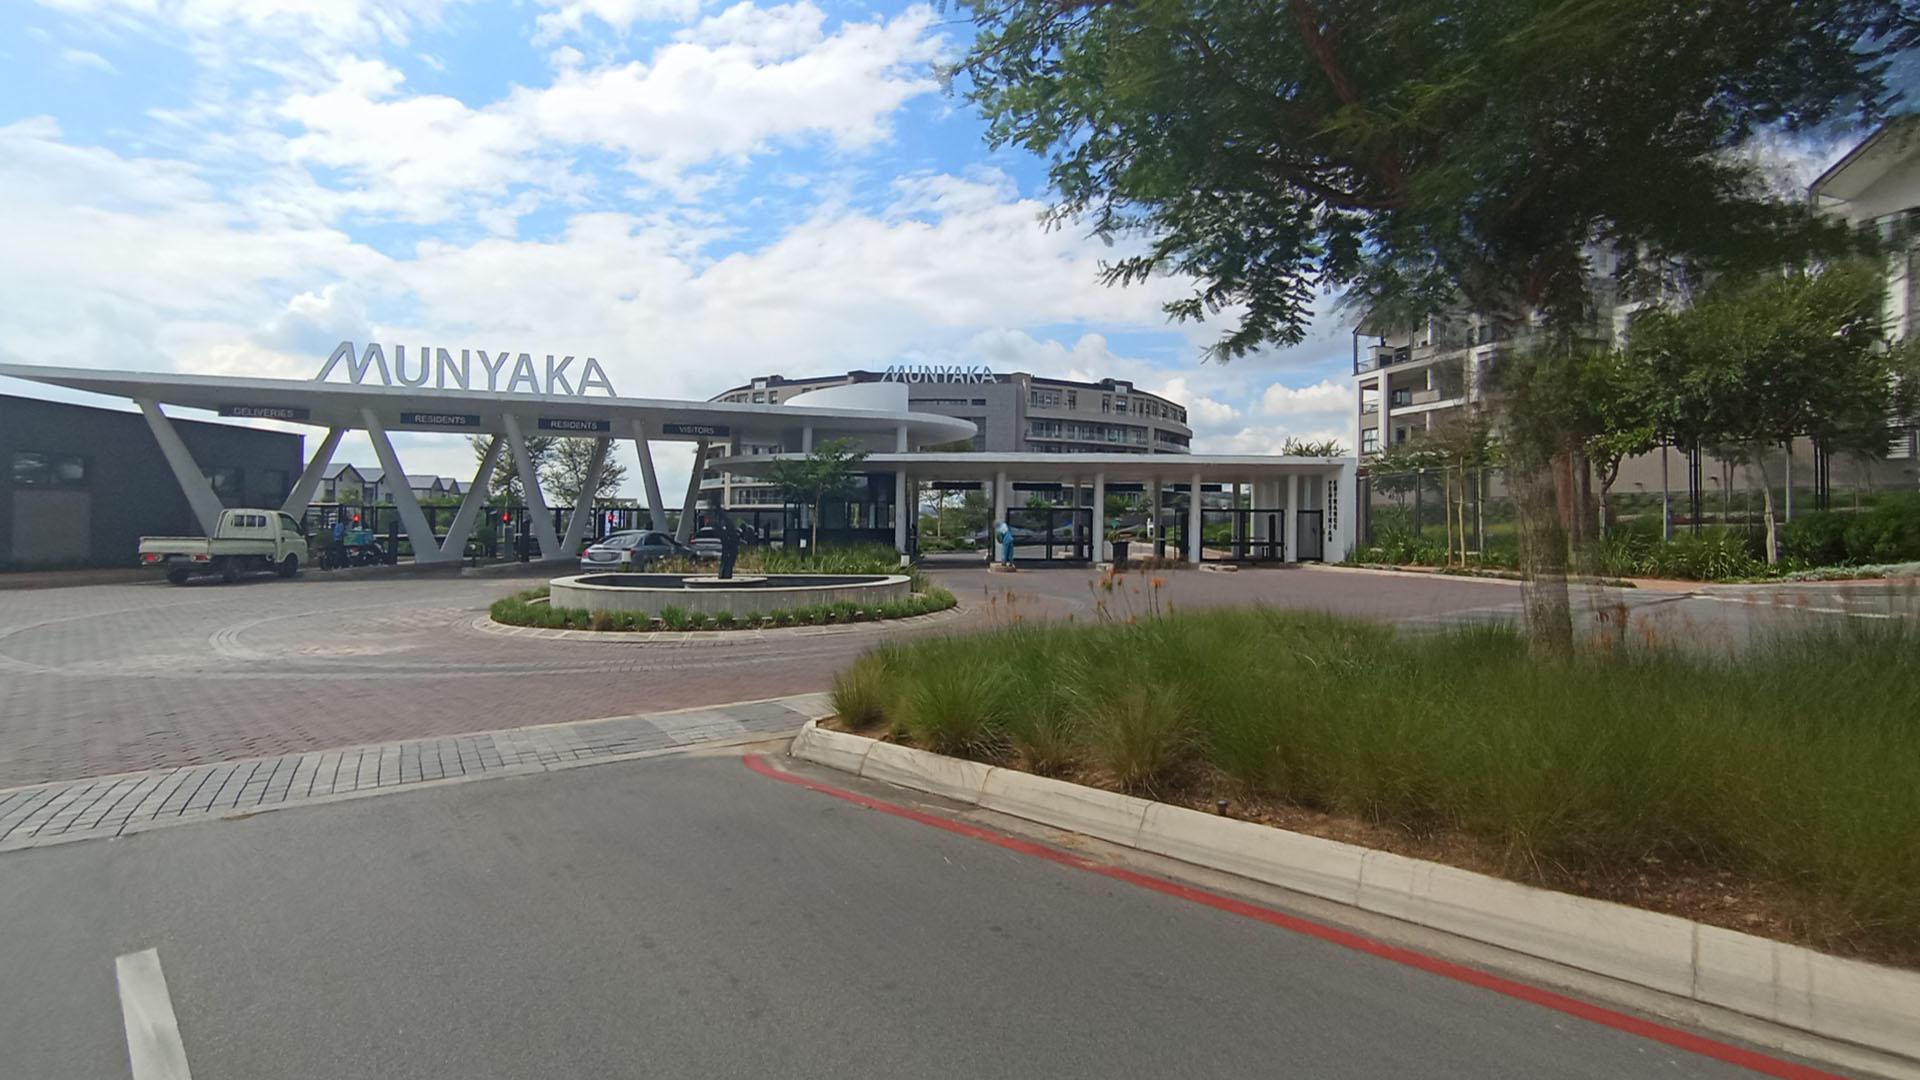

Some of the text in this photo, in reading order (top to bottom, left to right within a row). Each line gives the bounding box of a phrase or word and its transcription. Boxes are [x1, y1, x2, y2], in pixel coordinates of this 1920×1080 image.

[314, 340, 617, 397] MUNYAKA
[880, 365, 998, 384] MUNYAKA
[233, 407, 294, 418] DELIVERIES
[414, 414, 466, 425] RESIDENTS
[550, 420, 598, 431] RESIDENTS
[678, 426, 715, 435] VISITORS
